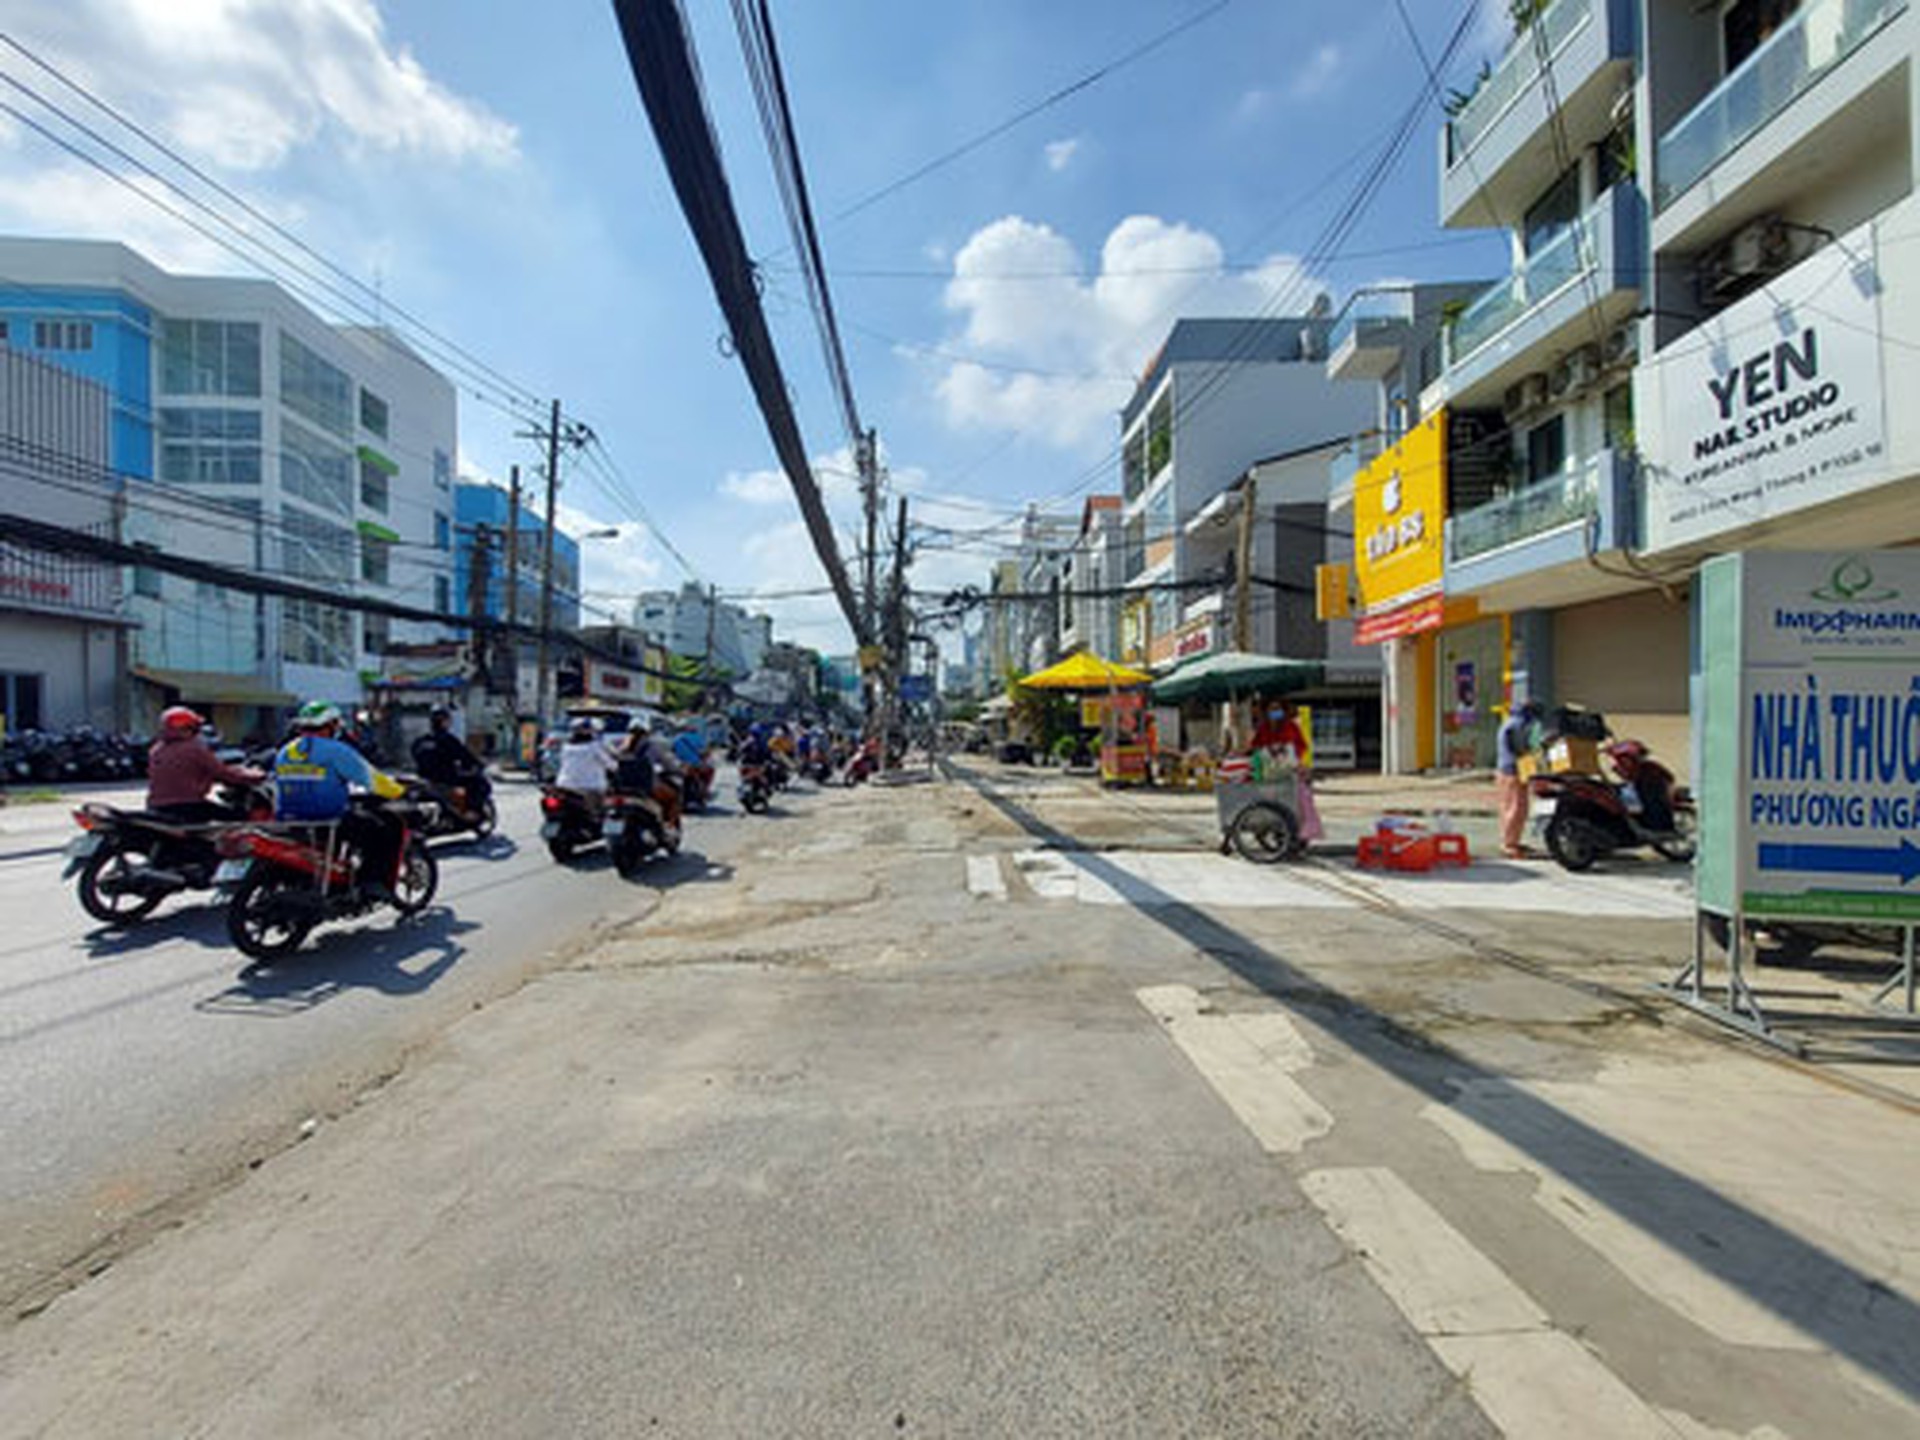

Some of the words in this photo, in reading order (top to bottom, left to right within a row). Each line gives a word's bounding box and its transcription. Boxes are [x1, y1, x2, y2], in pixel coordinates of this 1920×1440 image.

[1708, 328, 1818, 419] YEN
[1745, 382, 1839, 439] STUDIO
[1800, 408, 1858, 439] MORE
[1752, 674, 1822, 781] NHÀ
[1751, 788, 1865, 827] PHƯƠNG
